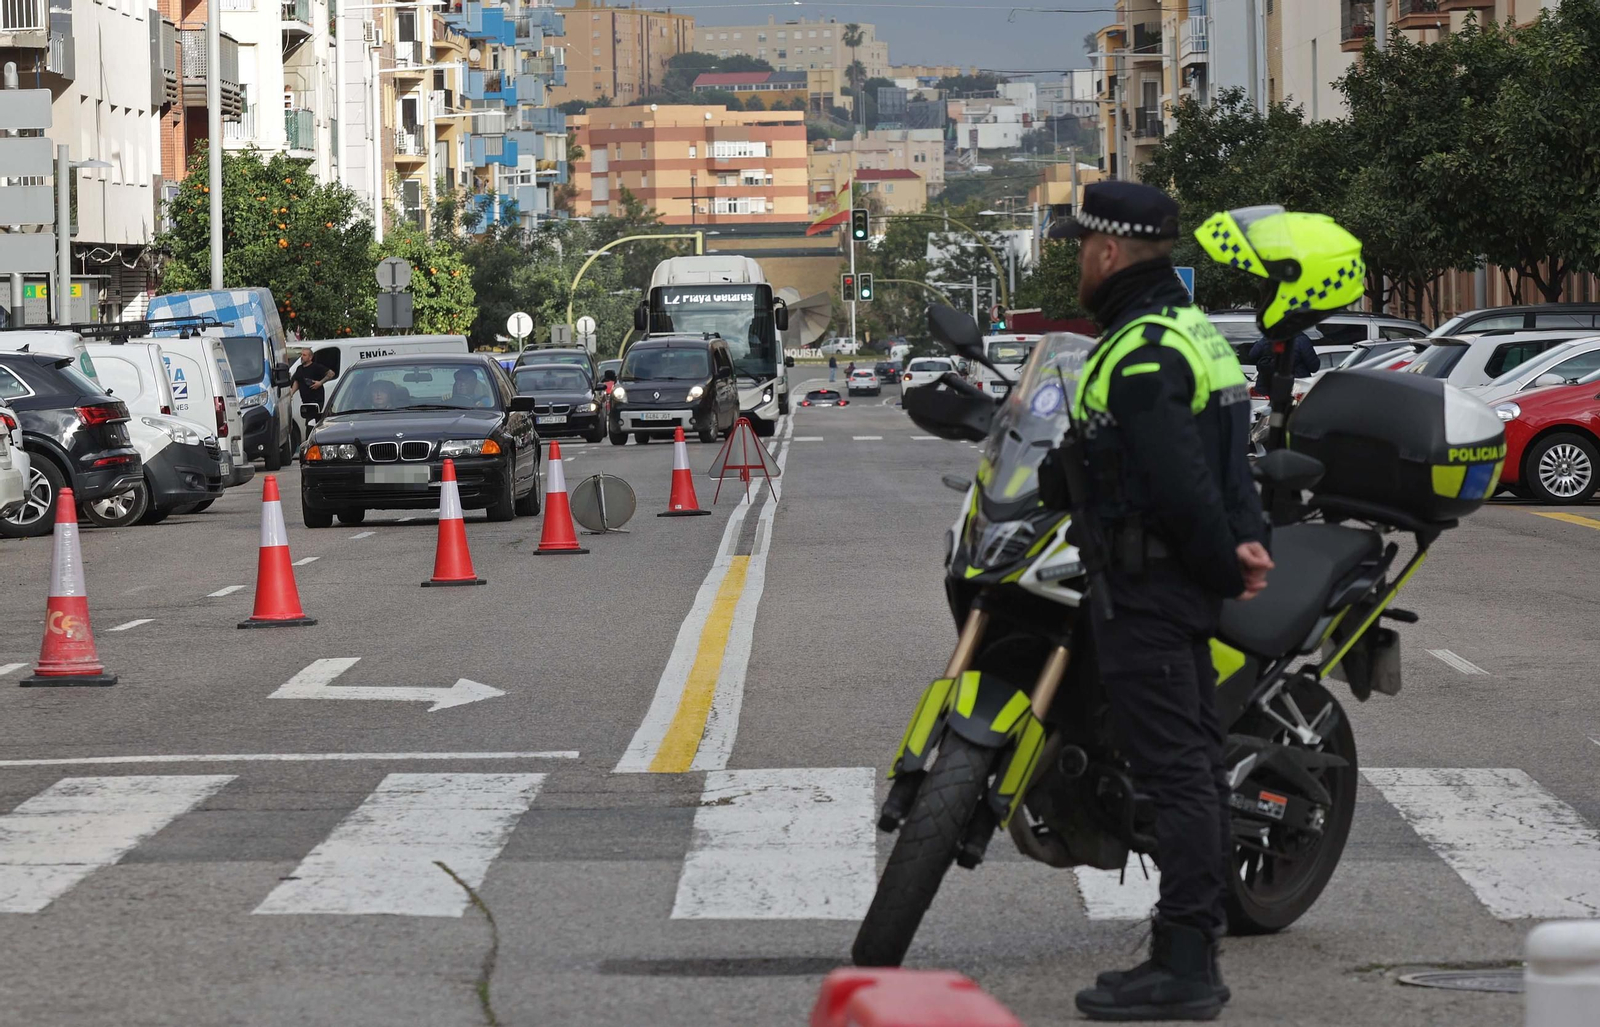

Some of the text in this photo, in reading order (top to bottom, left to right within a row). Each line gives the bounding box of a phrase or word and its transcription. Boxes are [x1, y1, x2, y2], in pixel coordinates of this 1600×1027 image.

[40, 286, 77, 296] OE
[682, 294, 711, 304] Playa
[1448, 445, 1498, 462] POLICIA
